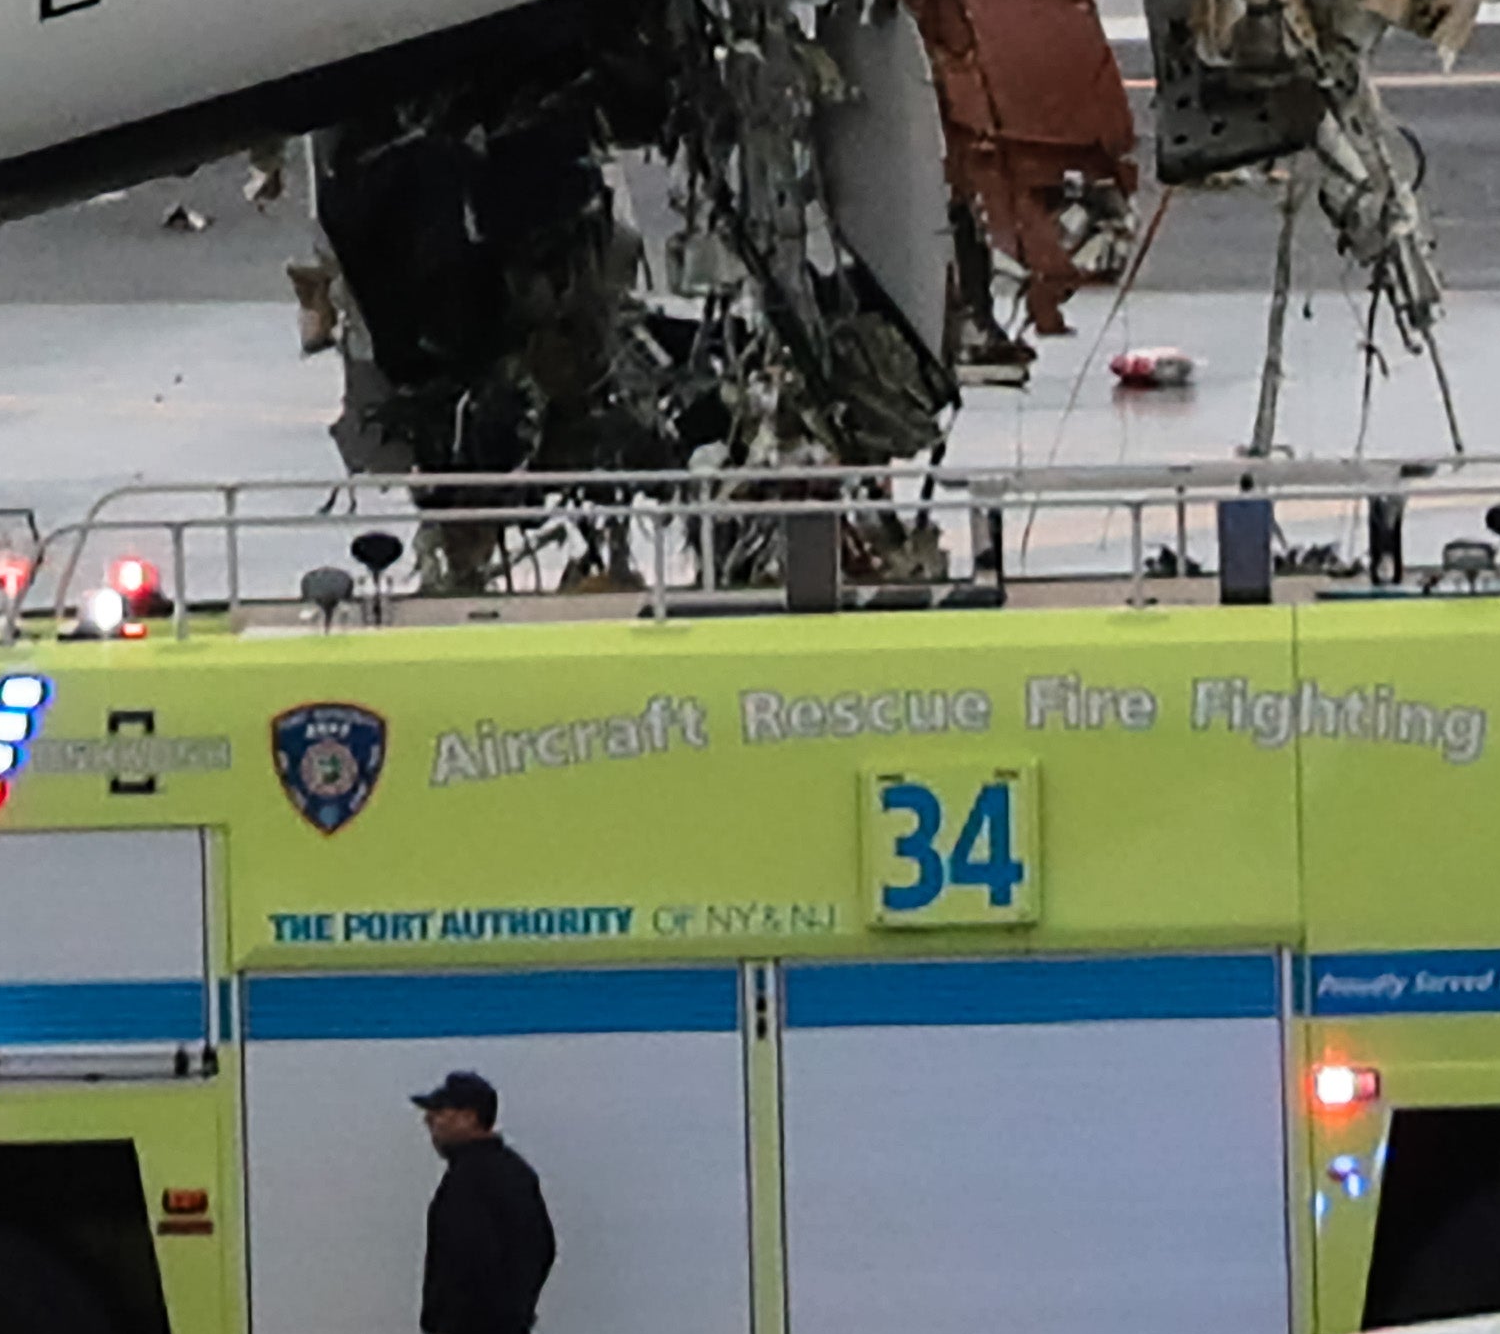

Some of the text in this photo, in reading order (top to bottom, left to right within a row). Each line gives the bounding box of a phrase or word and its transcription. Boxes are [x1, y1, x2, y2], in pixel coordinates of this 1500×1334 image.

[428, 673, 1487, 788] Aircraft Rescue Fire Fighting
[880, 782, 1025, 913] 34
[268, 914, 334, 942] THE
[343, 911, 433, 942] PORT
[440, 906, 634, 940] AUTHORITY
[652, 907, 694, 935] OF
